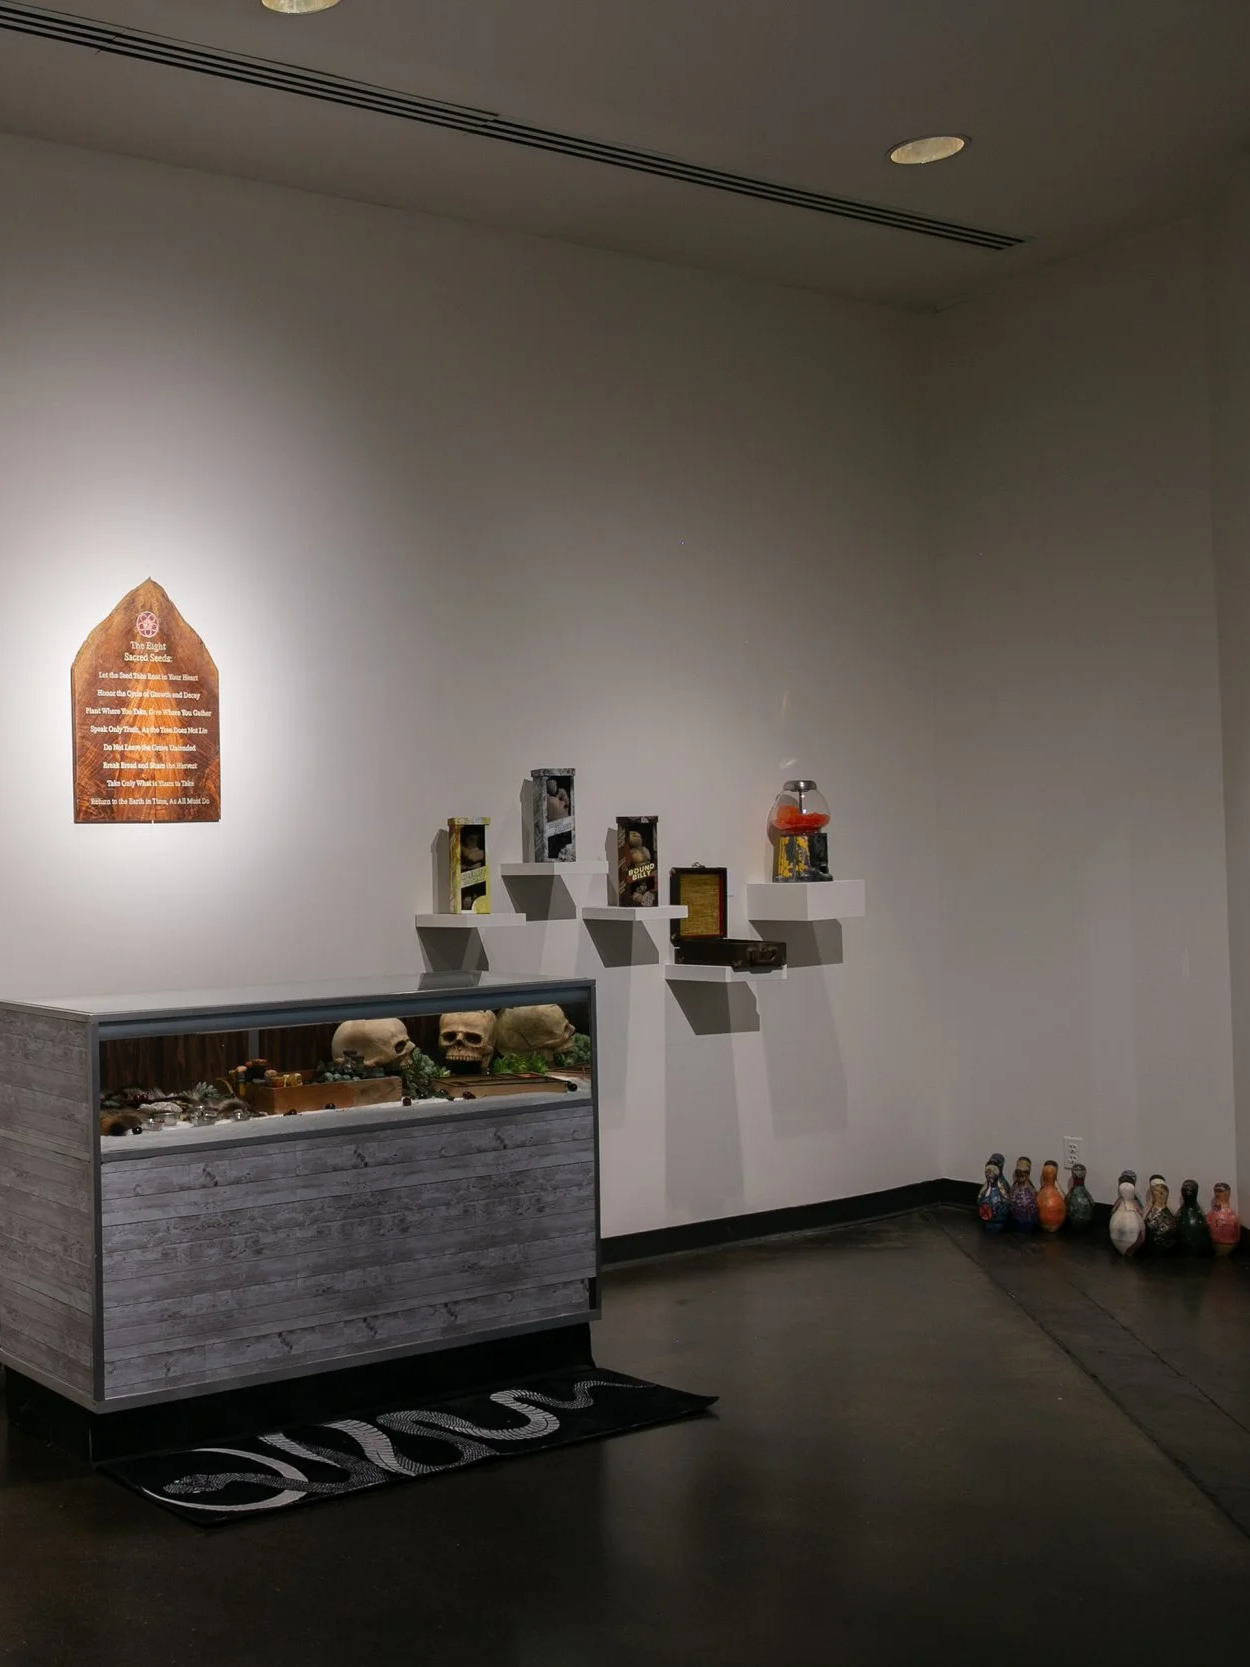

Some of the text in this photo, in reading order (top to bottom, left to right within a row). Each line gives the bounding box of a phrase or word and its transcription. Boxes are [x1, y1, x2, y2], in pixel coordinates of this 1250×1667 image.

[130, 641, 166, 652] The Eight
[124, 652, 172, 662] Sacred Seeds:
[133, 672, 146, 680] Take
[97, 689, 116, 697] Honor
[183, 692, 200, 700] Decay
[193, 709, 211, 717] Gather
[90, 726, 107, 734] Speak
[108, 726, 122, 734] Only
[121, 780, 135, 788] Only
[628, 863, 655, 876] BOUND
[632, 869, 651, 881] BILLY
